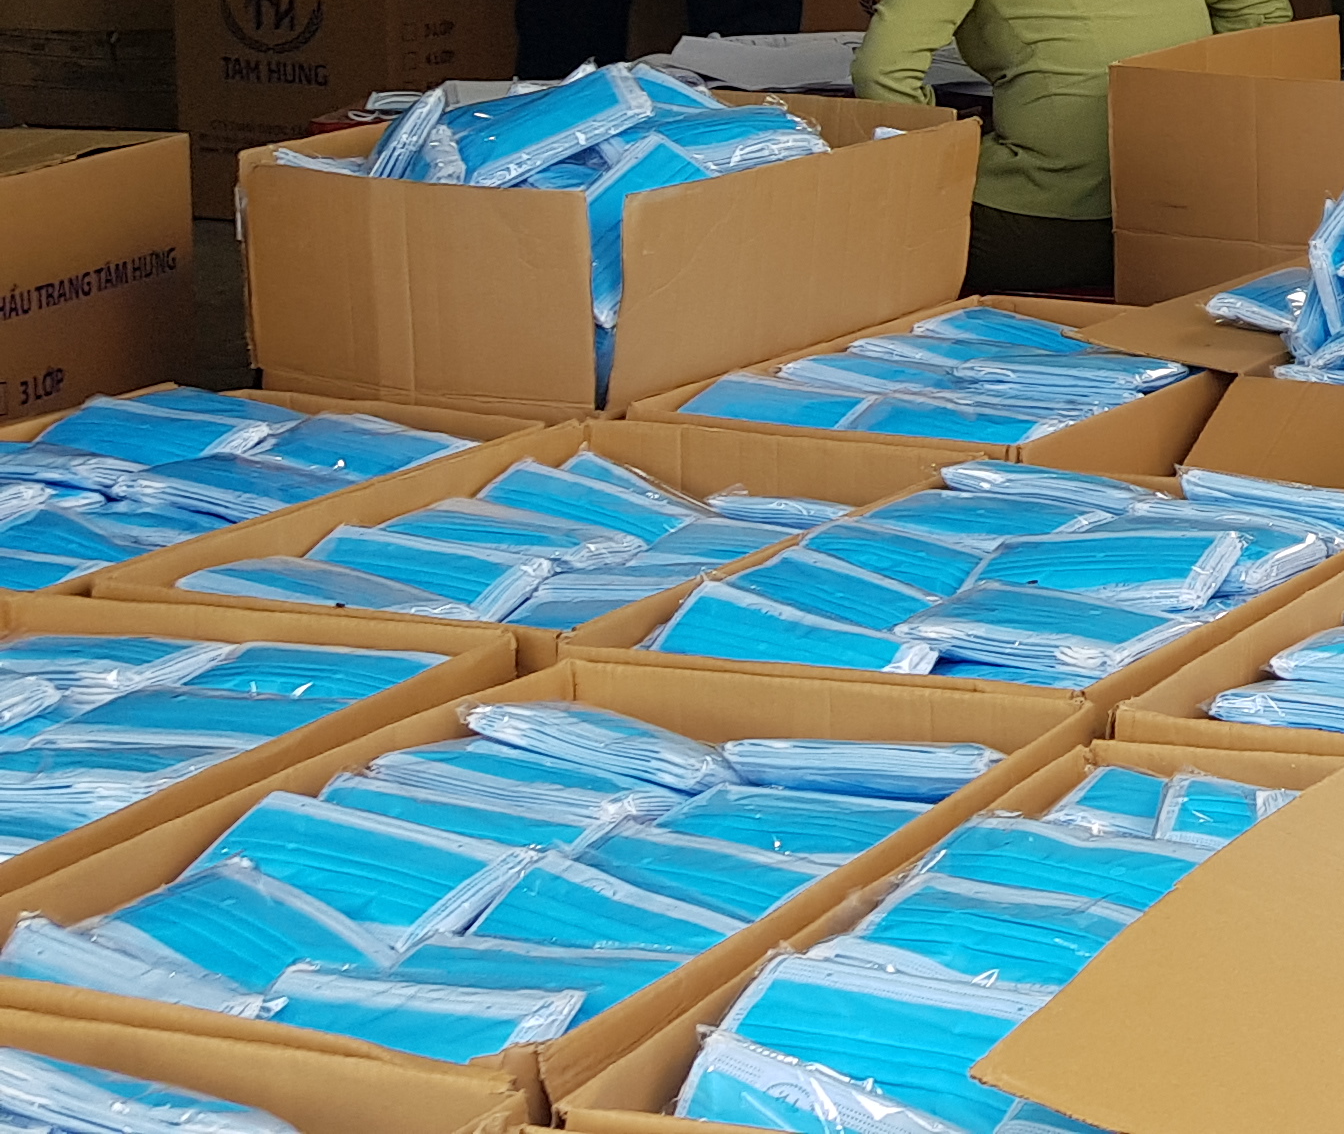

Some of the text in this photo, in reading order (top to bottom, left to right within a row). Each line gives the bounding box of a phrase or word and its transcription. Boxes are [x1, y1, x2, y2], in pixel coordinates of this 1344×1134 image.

[221, 55, 329, 87] TAM HUNG
[0, 283, 32, 322] HẨU
[34, 272, 92, 310] TRANG
[131, 247, 178, 282] HƯNG
[20, 365, 65, 405] 3 LỚP
